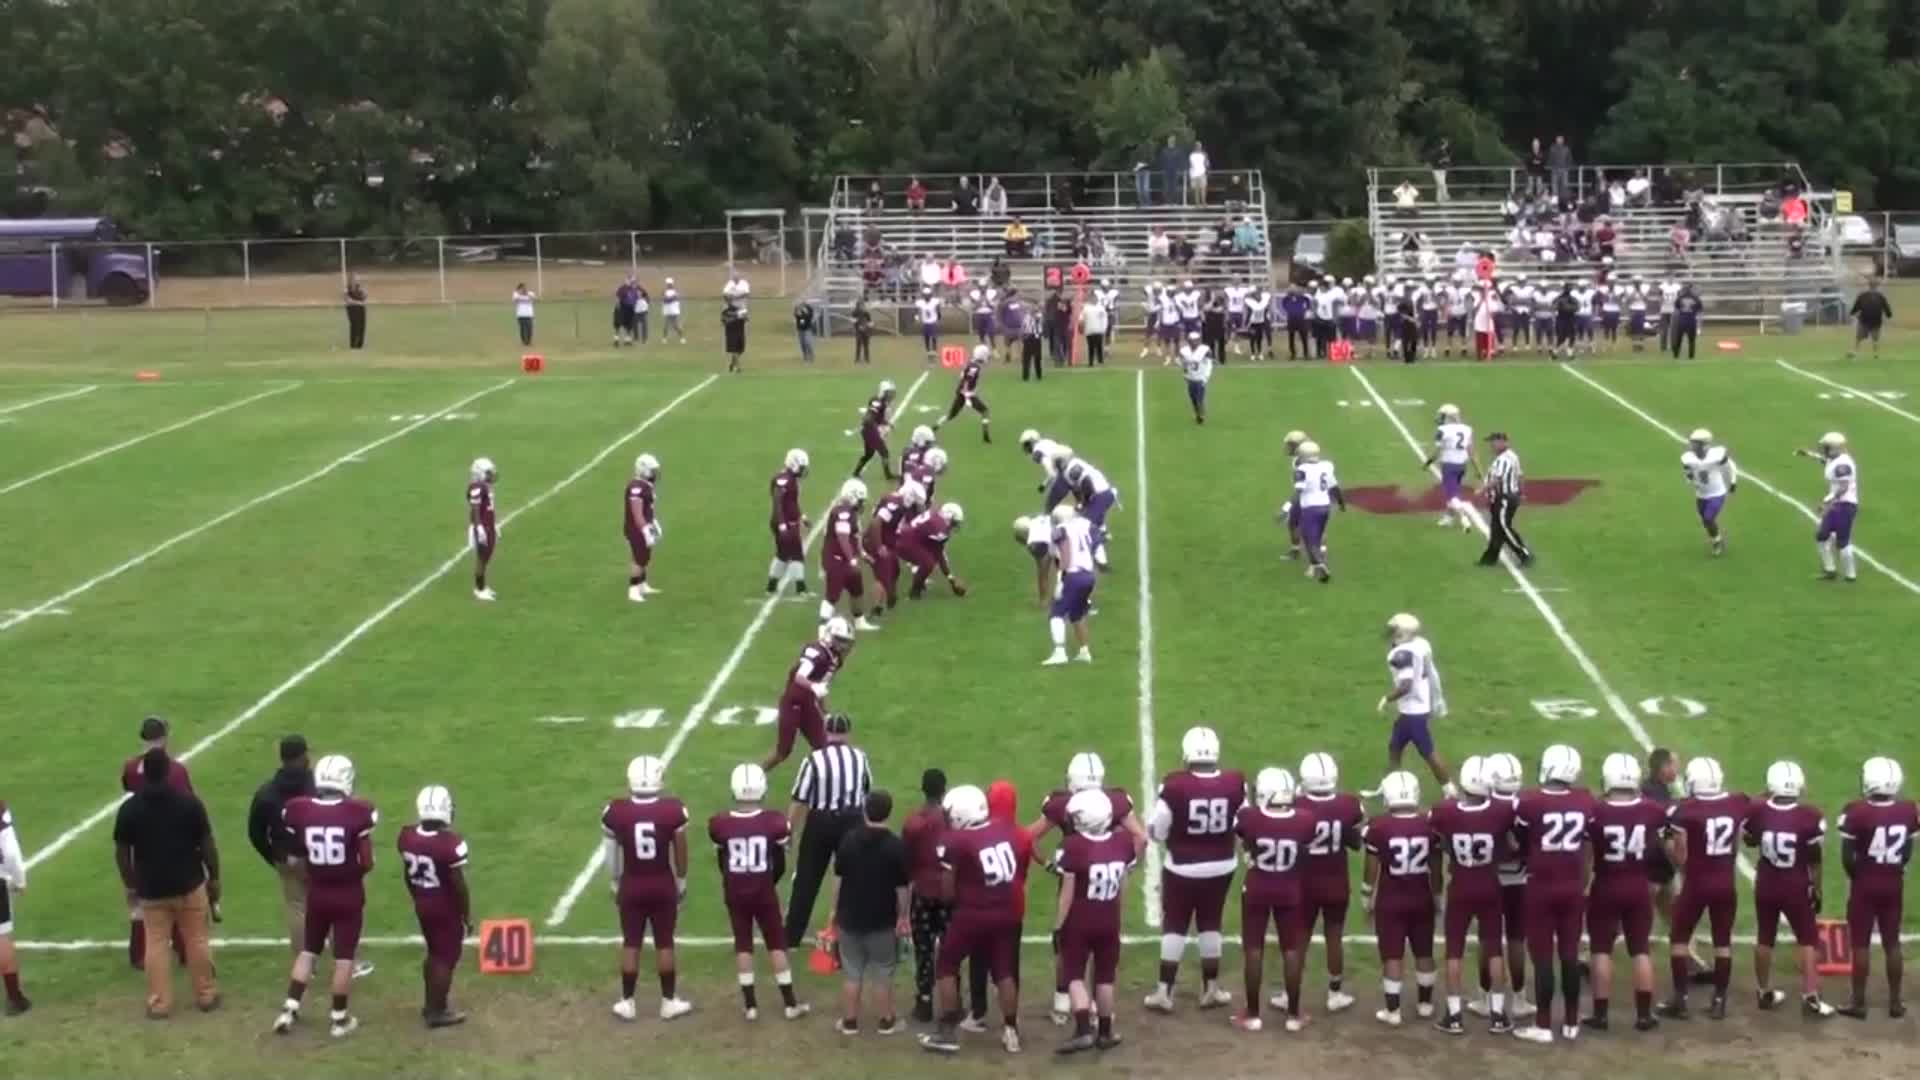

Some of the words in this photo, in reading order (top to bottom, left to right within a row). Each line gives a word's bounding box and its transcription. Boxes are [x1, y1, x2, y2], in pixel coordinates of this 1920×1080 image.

[1187, 798, 1229, 834] 58
[1541, 811, 1585, 851] 22
[634, 822, 657, 860] 6
[727, 835, 768, 873] 80
[1256, 838, 1297, 872] 20
[1309, 820, 1342, 854] 21
[1452, 833, 1494, 867] 83
[1603, 824, 1646, 861] 34
[1706, 816, 1734, 856] 12
[1761, 831, 1797, 868] 45
[1867, 825, 1907, 864] 42
[403, 851, 440, 888] 23
[979, 841, 1016, 886] 90
[1388, 837, 1429, 875] 32
[484, 925, 526, 967] 40
